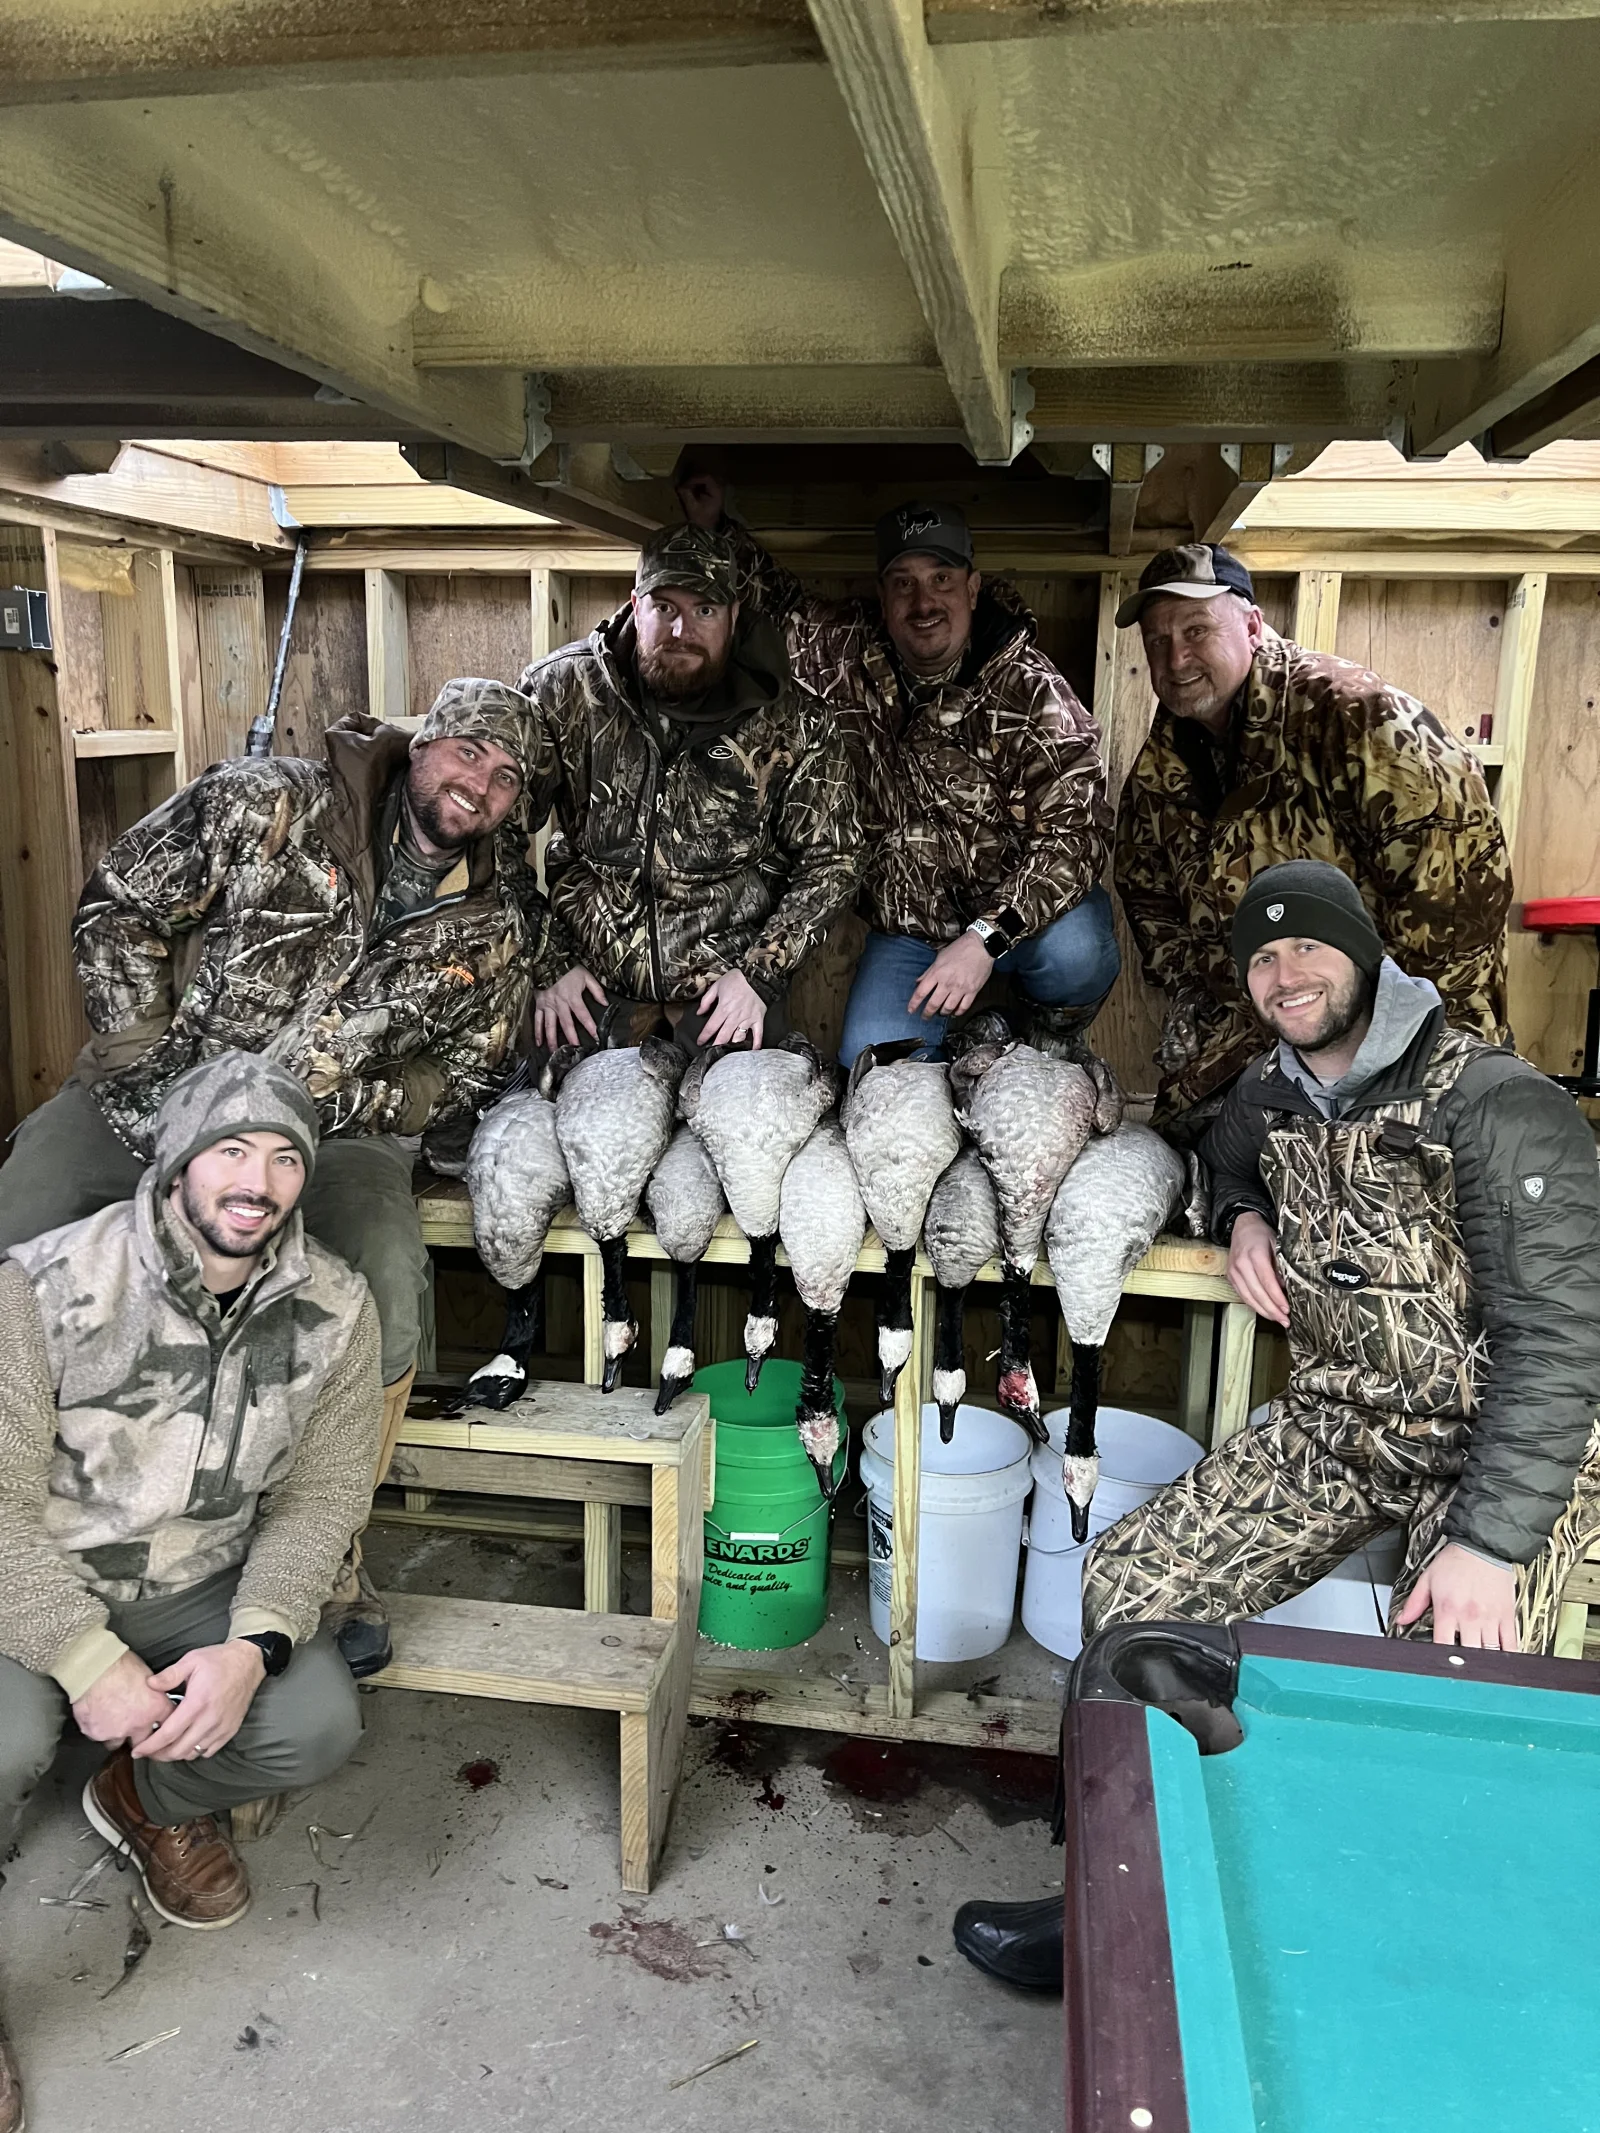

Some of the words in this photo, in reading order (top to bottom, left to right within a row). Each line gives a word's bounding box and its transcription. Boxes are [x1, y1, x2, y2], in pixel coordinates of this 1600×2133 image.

[704, 1536, 811, 1564] ENARDS
[708, 1563, 764, 1581] Dedicated
[766, 1572, 777, 1581] to
[726, 1581, 747, 1591] and
